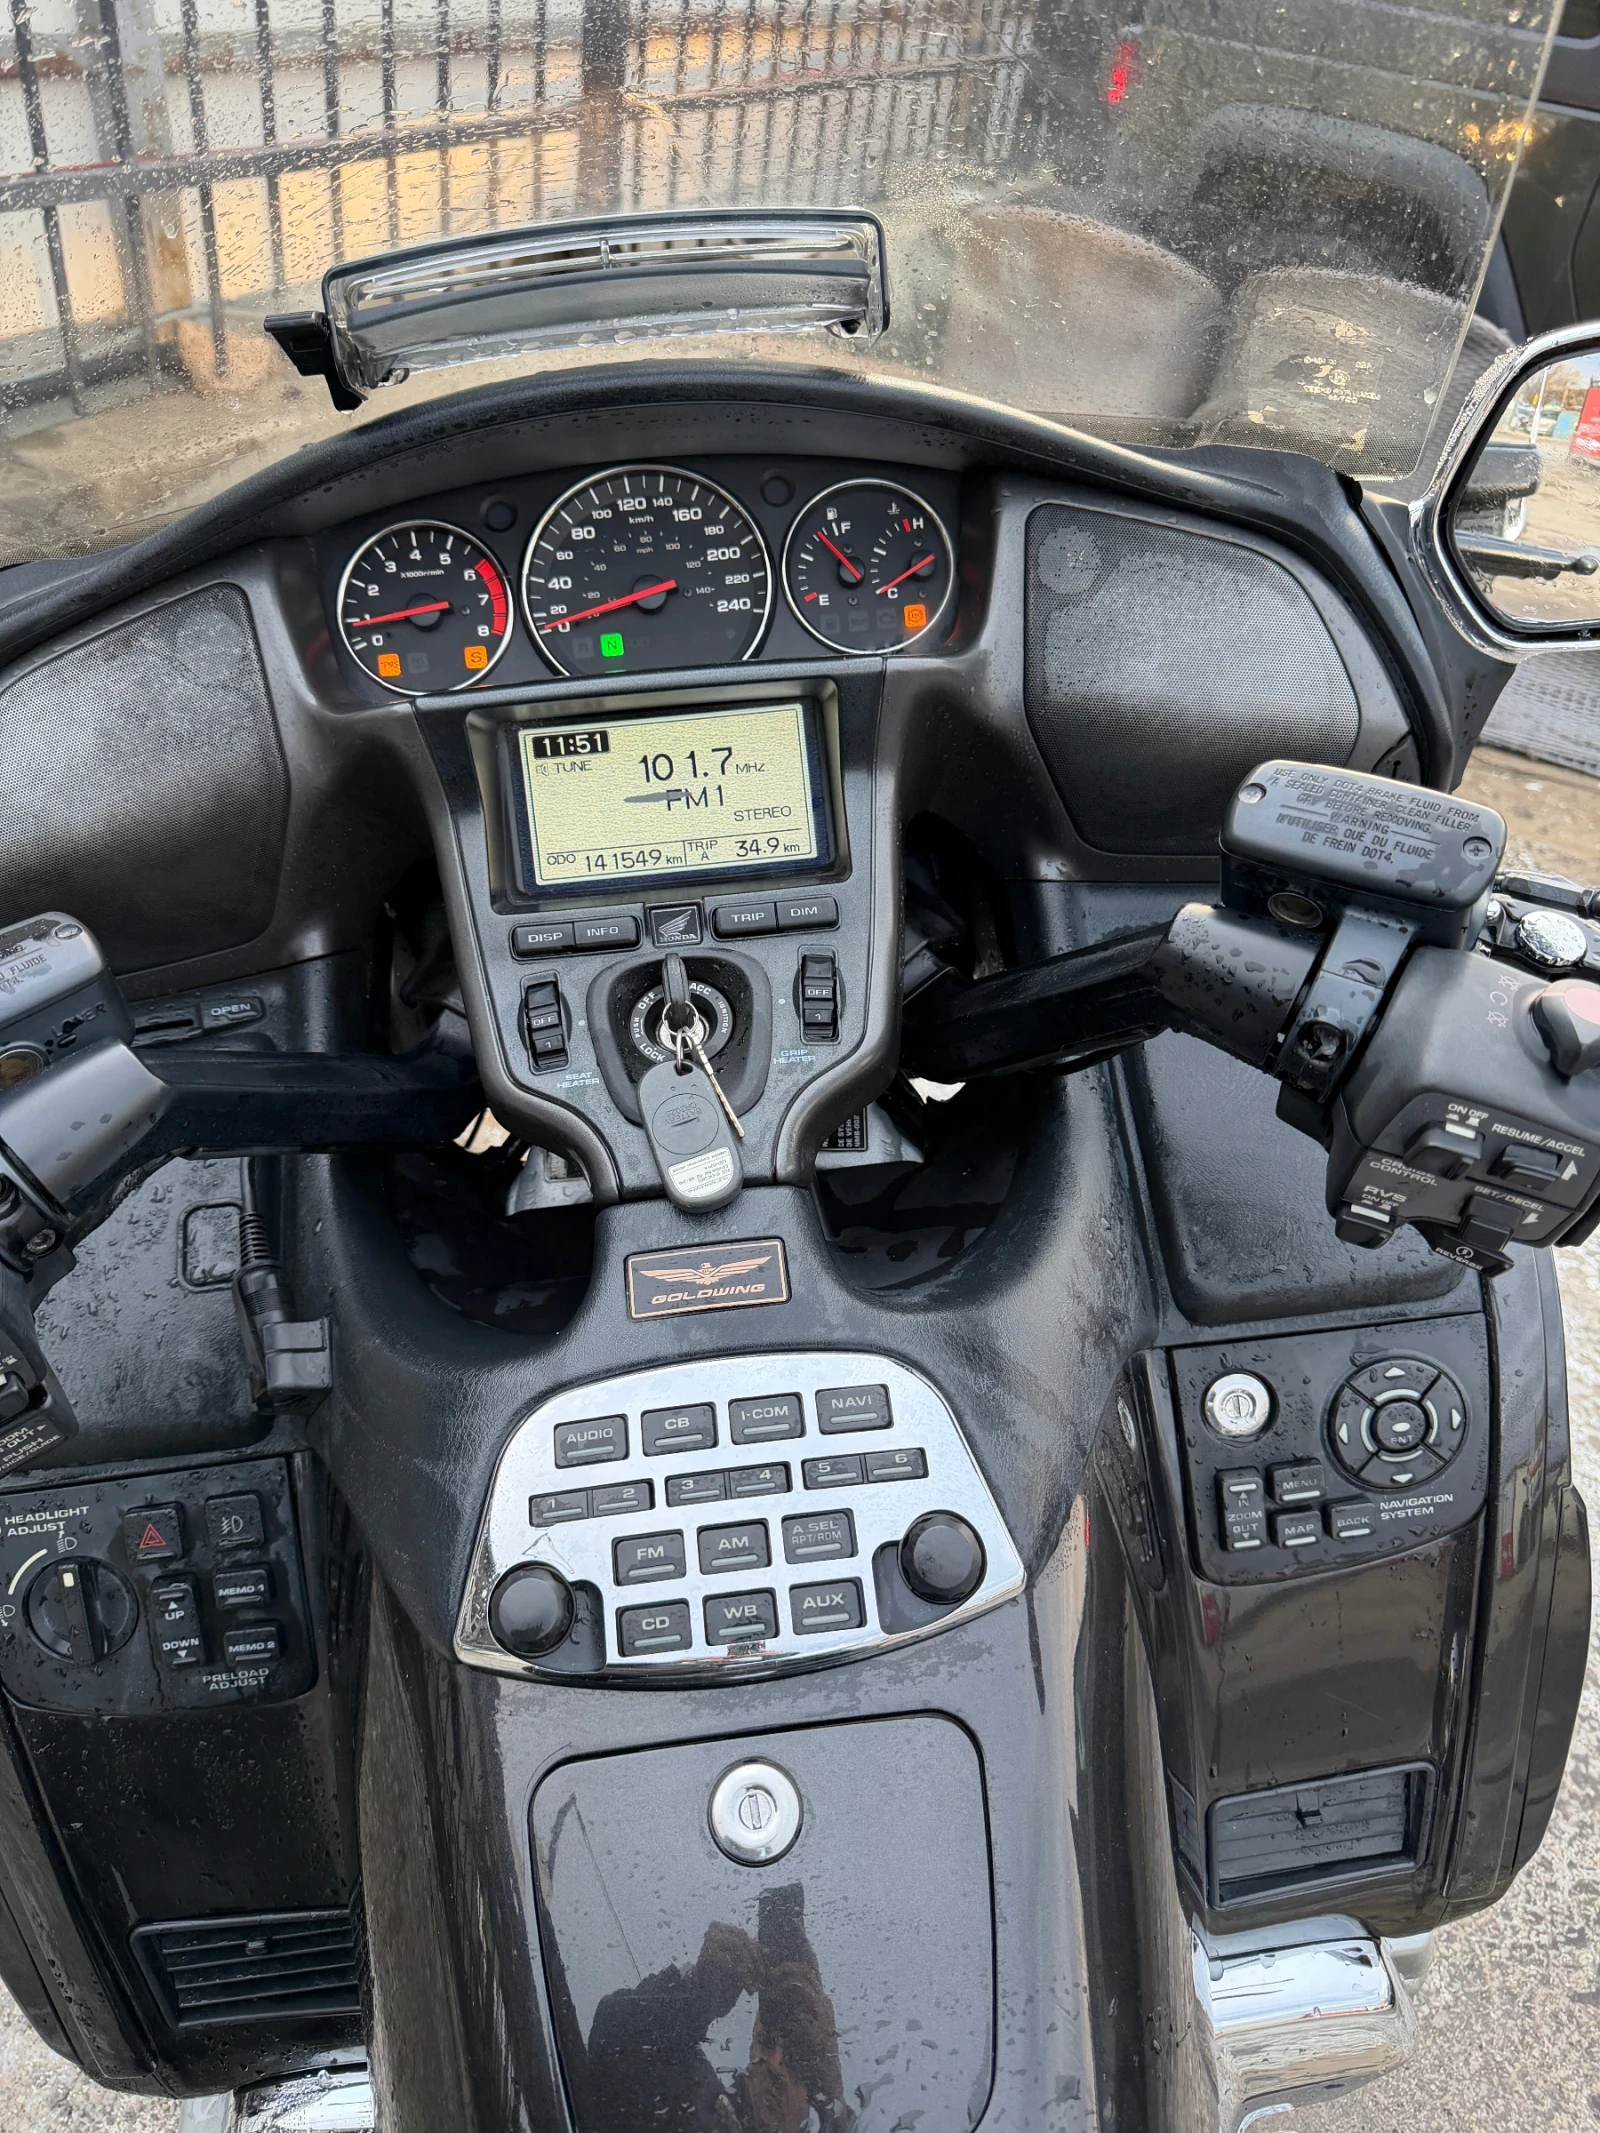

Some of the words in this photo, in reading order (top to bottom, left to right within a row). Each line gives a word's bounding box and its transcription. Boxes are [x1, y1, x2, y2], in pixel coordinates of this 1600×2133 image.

[617, 498, 647, 511] 120
[652, 497, 673, 508] 140
[591, 509, 612, 520] 100
[629, 516, 654, 524] km/h
[672, 508, 702, 522] 160
[840, 521, 852, 534] F
[912, 516, 924, 529] H
[571, 526, 596, 540] 80
[704, 525, 724, 536] 180
[409, 549, 422, 561] 4
[439, 553, 451, 565] 5
[556, 551, 573, 561] 60
[706, 547, 740, 561] 200
[384, 561, 397, 573] 3
[463, 569, 477, 582] 6
[725, 574, 750, 584] 220
[548, 577, 572, 589] 40
[367, 584, 380, 597] 2
[887, 588, 898, 599] C
[477, 593, 490, 606] 7
[717, 599, 751, 612] 240
[819, 594, 830, 606] E
[550, 605, 567, 615] 20
[477, 625, 490, 636] 8
[557, 621, 571, 633] 0
[371, 635, 383, 646] 0
[471, 652, 482, 663] S
[542, 733, 604, 757] 11:51
[554, 760, 593, 774] TUNE
[639, 747, 733, 783] 101.7
[1274, 768, 1296, 779] USE
[1300, 772, 1329, 786] ONLY
[1367, 787, 1405, 803] BRAKE
[1410, 797, 1442, 812] FLUID
[1447, 807, 1480, 823] FROM
[734, 806, 792, 822] STEREO
[1324, 800, 1369, 817] BEFORE
[1329, 811, 1390, 834] WARNING
[1395, 804, 1430, 820] CLEAN
[1435, 815, 1471, 833] FILLER
[687, 840, 718, 852] TRIP
[734, 837, 780, 857] 34.9
[783, 841, 801, 853] km
[1301, 831, 1319, 844] DE
[1322, 836, 1358, 853] FREIN
[1361, 846, 1394, 864] DOT4.
[1343, 828, 1367, 842] QUE
[1371, 835, 1388, 847] DU
[1393, 842, 1435, 860] FLUIDE
[546, 853, 577, 866] ODO
[585, 849, 662, 872] 141549
[666, 853, 683, 865] km
[700, 851, 710, 862] A
[731, 911, 765, 923] TRIP
[790, 905, 818, 918] DIM
[528, 931, 563, 943] DISP
[587, 925, 619, 937] INFO
[659, 932, 697, 943] HONDA
[9, 953, 47, 976] FLUIDE
[689, 982, 712, 996] ACC
[807, 987, 831, 998] OFF
[637, 991, 656, 1010] OFF
[210, 1002, 250, 1017] OPEN
[533, 1016, 556, 1027] OFF
[717, 1001, 729, 1034] IGNITION
[633, 1017, 641, 1038] PUSH
[639, 1042, 667, 1062] LOCK
[773, 1053, 816, 1064] HEATER
[780, 1049, 808, 1058] GRIP
[565, 1071, 593, 1082] SEAT
[556, 1078, 600, 1089] HEATER
[1447, 1103, 1467, 1114] ON
[1468, 1109, 1489, 1120] OFF
[1491, 1123, 1586, 1157] RESUME/ACCEL
[1369, 1161, 1438, 1186] CONTROL
[1362, 1193, 1380, 1202] ON
[1381, 1199, 1399, 1207] OFF
[1363, 1184, 1407, 1203] RVS
[1474, 1185, 1545, 1212] SET/DECEL
[1435, 1247, 1484, 1271] REVERSE
[651, 1283, 766, 1305] GOLDWING
[831, 1395, 873, 1409] NAVI
[741, 1405, 789, 1421] I-COM
[664, 1416, 691, 1430] CB
[7, 1428, 35, 1448] OUT
[566, 1427, 614, 1444] AUDIO
[1390, 1435, 1414, 1445] ENT
[2, 1437, 44, 1463] PUSH
[895, 1453, 908, 1464] 6
[818, 1462, 831, 1473] 5
[759, 1469, 772, 1481] 4
[681, 1479, 695, 1490] 3
[1282, 1478, 1317, 1490] MENU
[623, 1488, 635, 1499] 2
[548, 1499, 556, 1509] 1
[1238, 1499, 1249, 1508] IN
[1379, 1493, 1454, 1510] NAVIGATION
[4, 1505, 90, 1525] HEADLIGHT
[1227, 1510, 1263, 1521] ZOOM
[1380, 1506, 1434, 1520] SYSTEM
[792, 1521, 839, 1535] A.SEL
[1232, 1522, 1258, 1534] OUT
[1337, 1516, 1370, 1527] BACK
[6, 1521, 65, 1537] ADJUST
[1284, 1524, 1314, 1535] MAP
[718, 1536, 749, 1551] AM
[792, 1531, 842, 1545] RPT/RDM
[636, 1546, 664, 1561] FM
[218, 1584, 255, 1596] MEMO
[802, 1593, 845, 1609] AUX
[164, 1610, 185, 1621] UP
[724, 1604, 758, 1619] WB
[641, 1616, 670, 1631] CD
[162, 1637, 200, 1651] DOWN
[228, 1643, 264, 1653] MEMO
[266, 1640, 276, 1649] 2
[202, 1668, 270, 1684] PRELOAD
[208, 1676, 267, 1692] ADJUST
